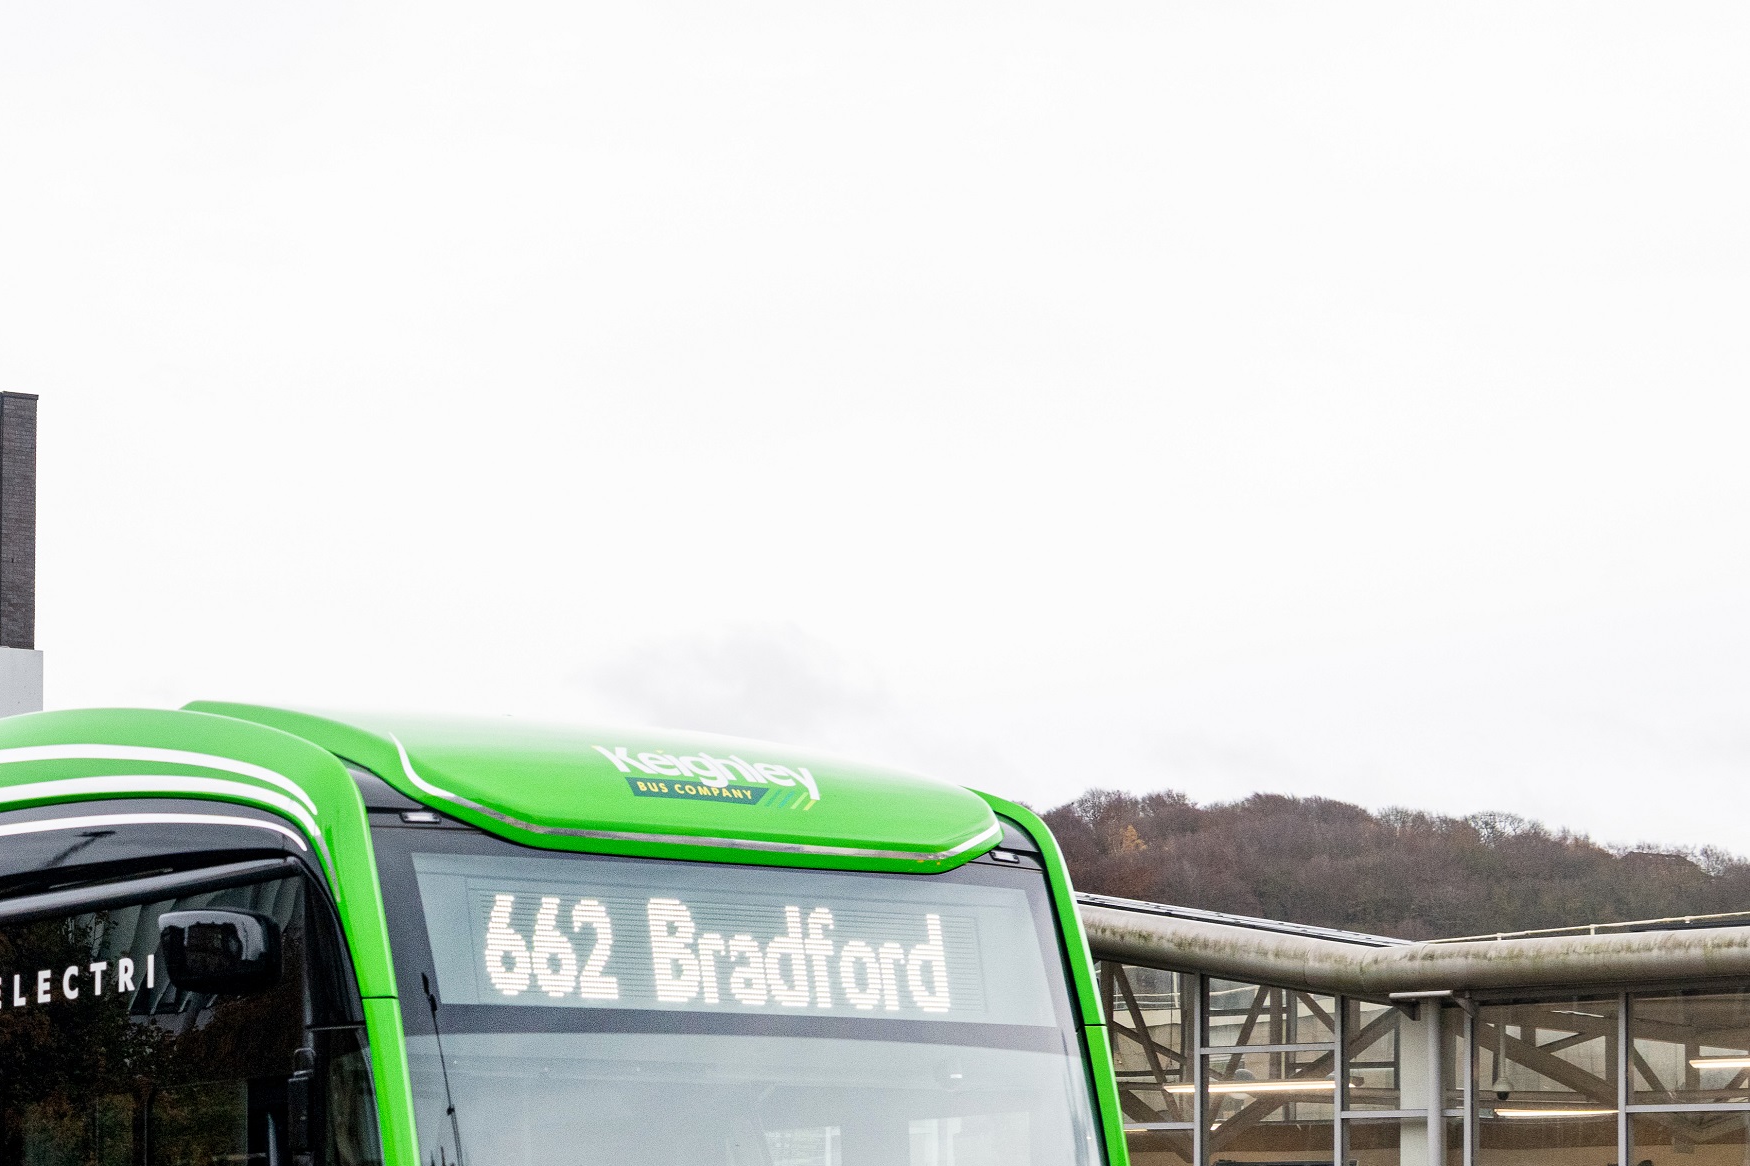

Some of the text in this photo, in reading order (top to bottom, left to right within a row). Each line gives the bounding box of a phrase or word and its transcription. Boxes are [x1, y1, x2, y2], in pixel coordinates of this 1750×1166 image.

[591, 745, 820, 800] Keighley
[636, 781, 752, 800] BUS COMPANY
[485, 894, 950, 1012] 662 Bradford
